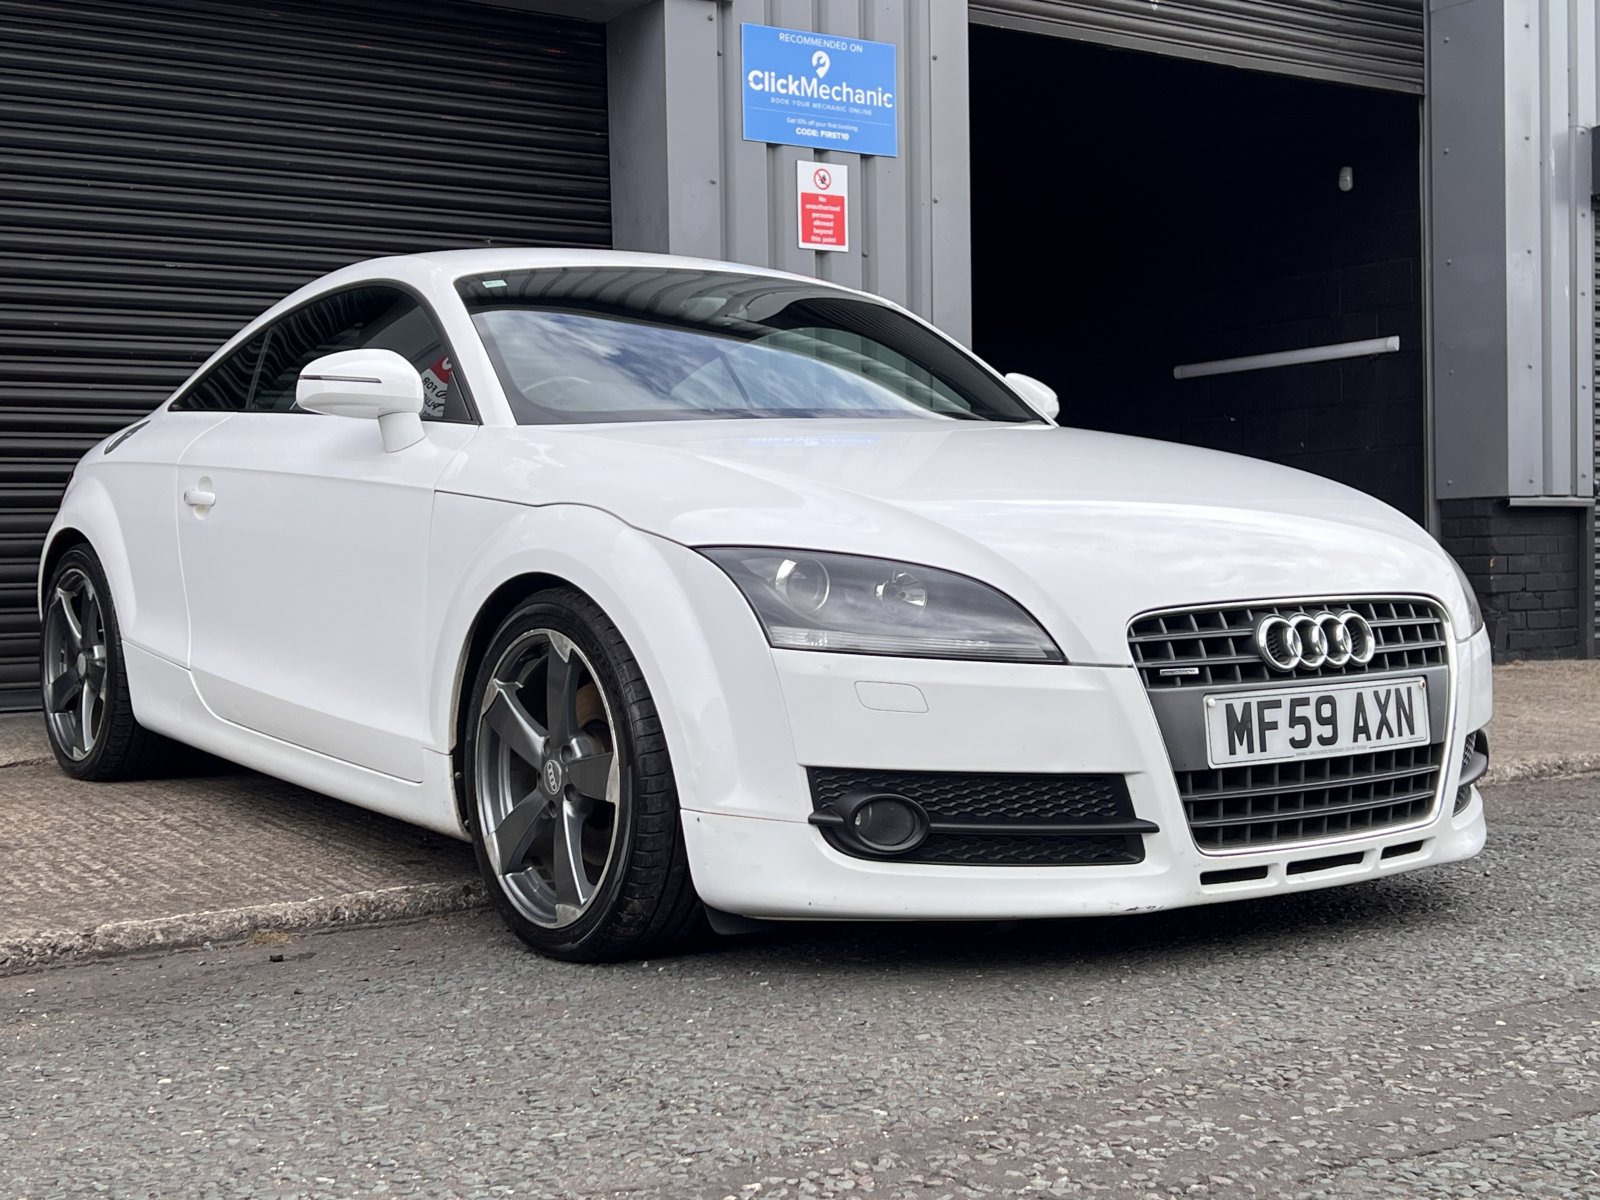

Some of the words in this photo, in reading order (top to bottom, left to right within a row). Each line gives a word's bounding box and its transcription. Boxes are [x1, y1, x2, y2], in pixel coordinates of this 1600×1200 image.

[779, 33, 847, 51] RECOMMENDED
[850, 43, 863, 53] ON
[748, 69, 893, 108] ClickMechanic
[771, 97, 789, 105] BOOK
[792, 99, 810, 108] YOUR
[812, 102, 846, 112] MECHANIC
[849, 106, 872, 116] ONLINE
[795, 127, 819, 137] CODE:
[820, 130, 850, 141] FIRST10
[1225, 695, 1339, 756] MF59
[1352, 686, 1416, 743] AXN
